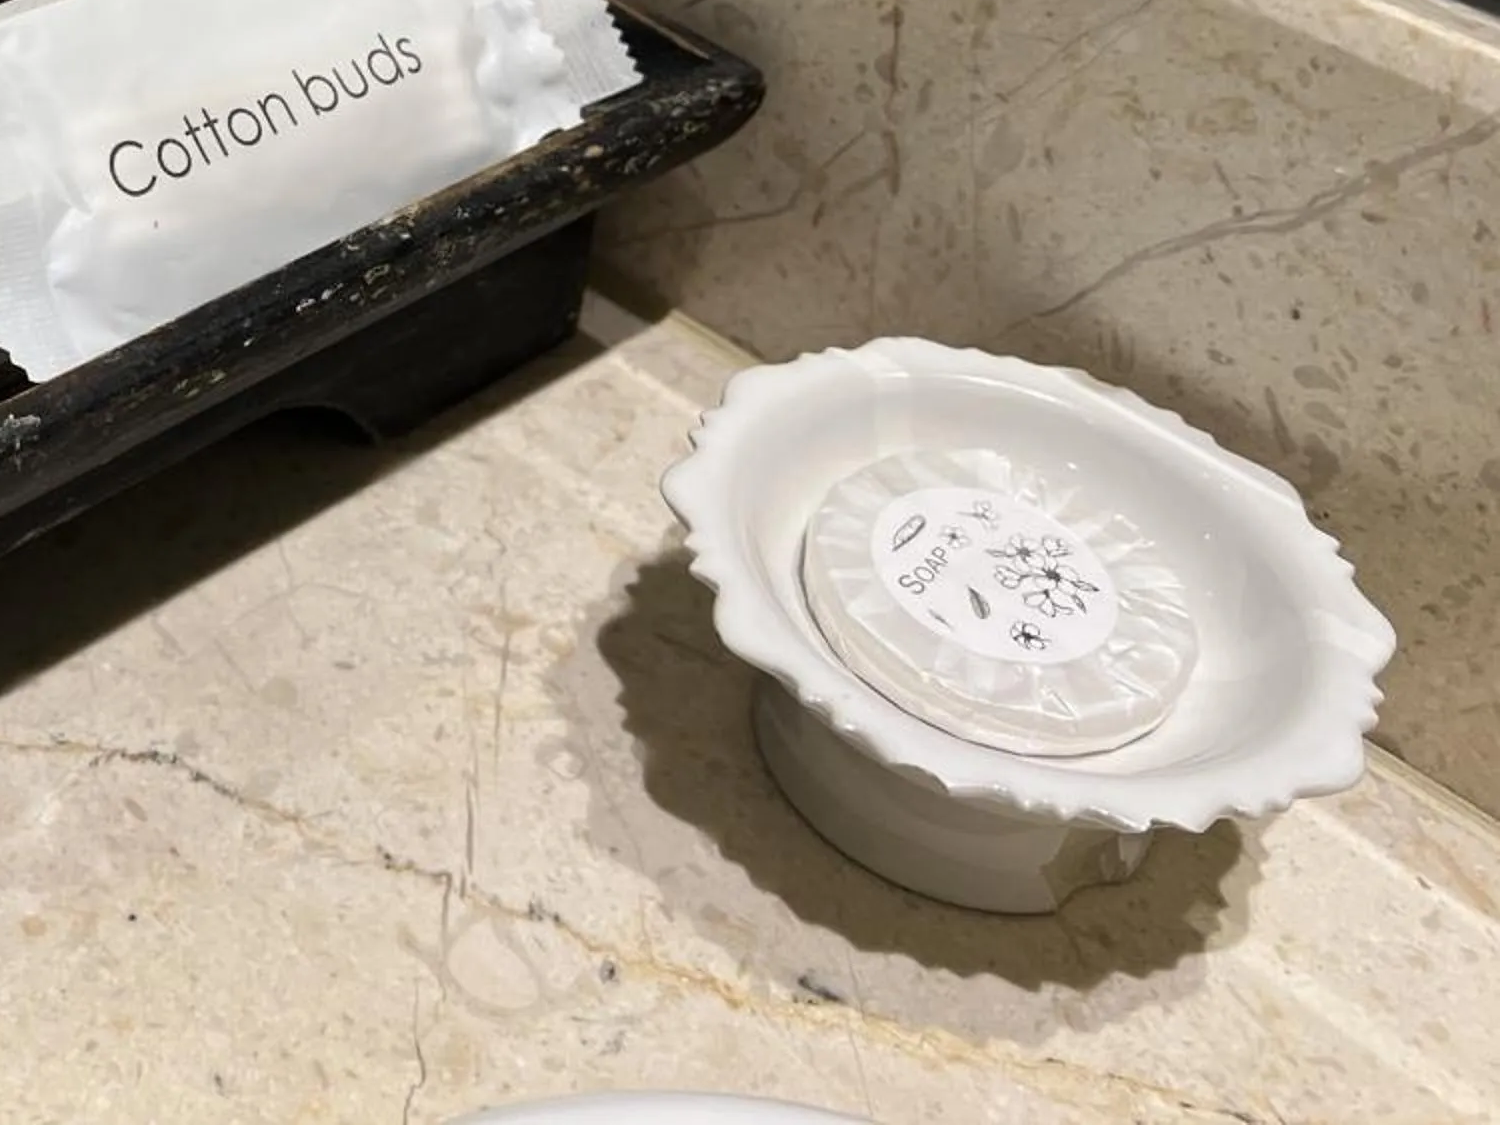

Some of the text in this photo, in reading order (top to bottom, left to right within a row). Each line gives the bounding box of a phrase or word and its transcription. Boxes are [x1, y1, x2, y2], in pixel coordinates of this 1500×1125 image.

[108, 32, 422, 198] Cotton buds
[898, 546, 949, 595] SOAP
